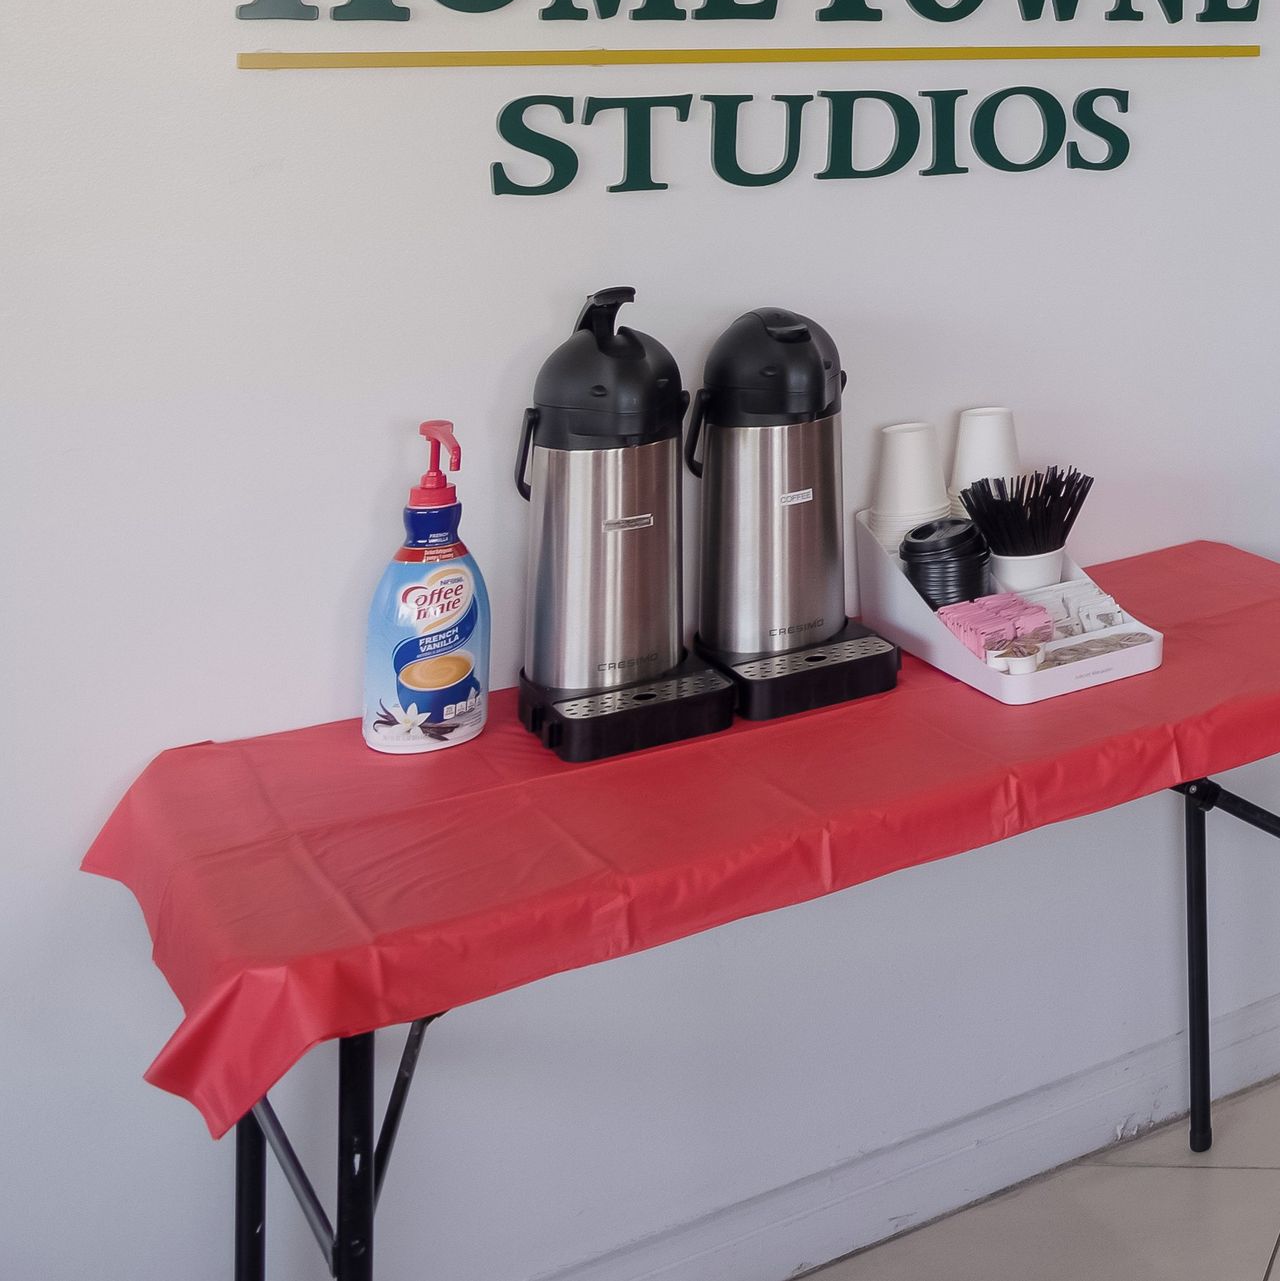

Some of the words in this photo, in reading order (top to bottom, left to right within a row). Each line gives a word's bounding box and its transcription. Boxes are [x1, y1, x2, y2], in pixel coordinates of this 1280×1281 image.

[490, 86, 1131, 196] STUDIOS
[780, 490, 812, 505] COFFEE
[402, 584, 464, 607] Coffee
[419, 626, 459, 646] FRENCH
[769, 618, 824, 637] CRESIMO
[420, 634, 460, 653] VANILLA
[598, 652, 658, 672] CRESIMO
